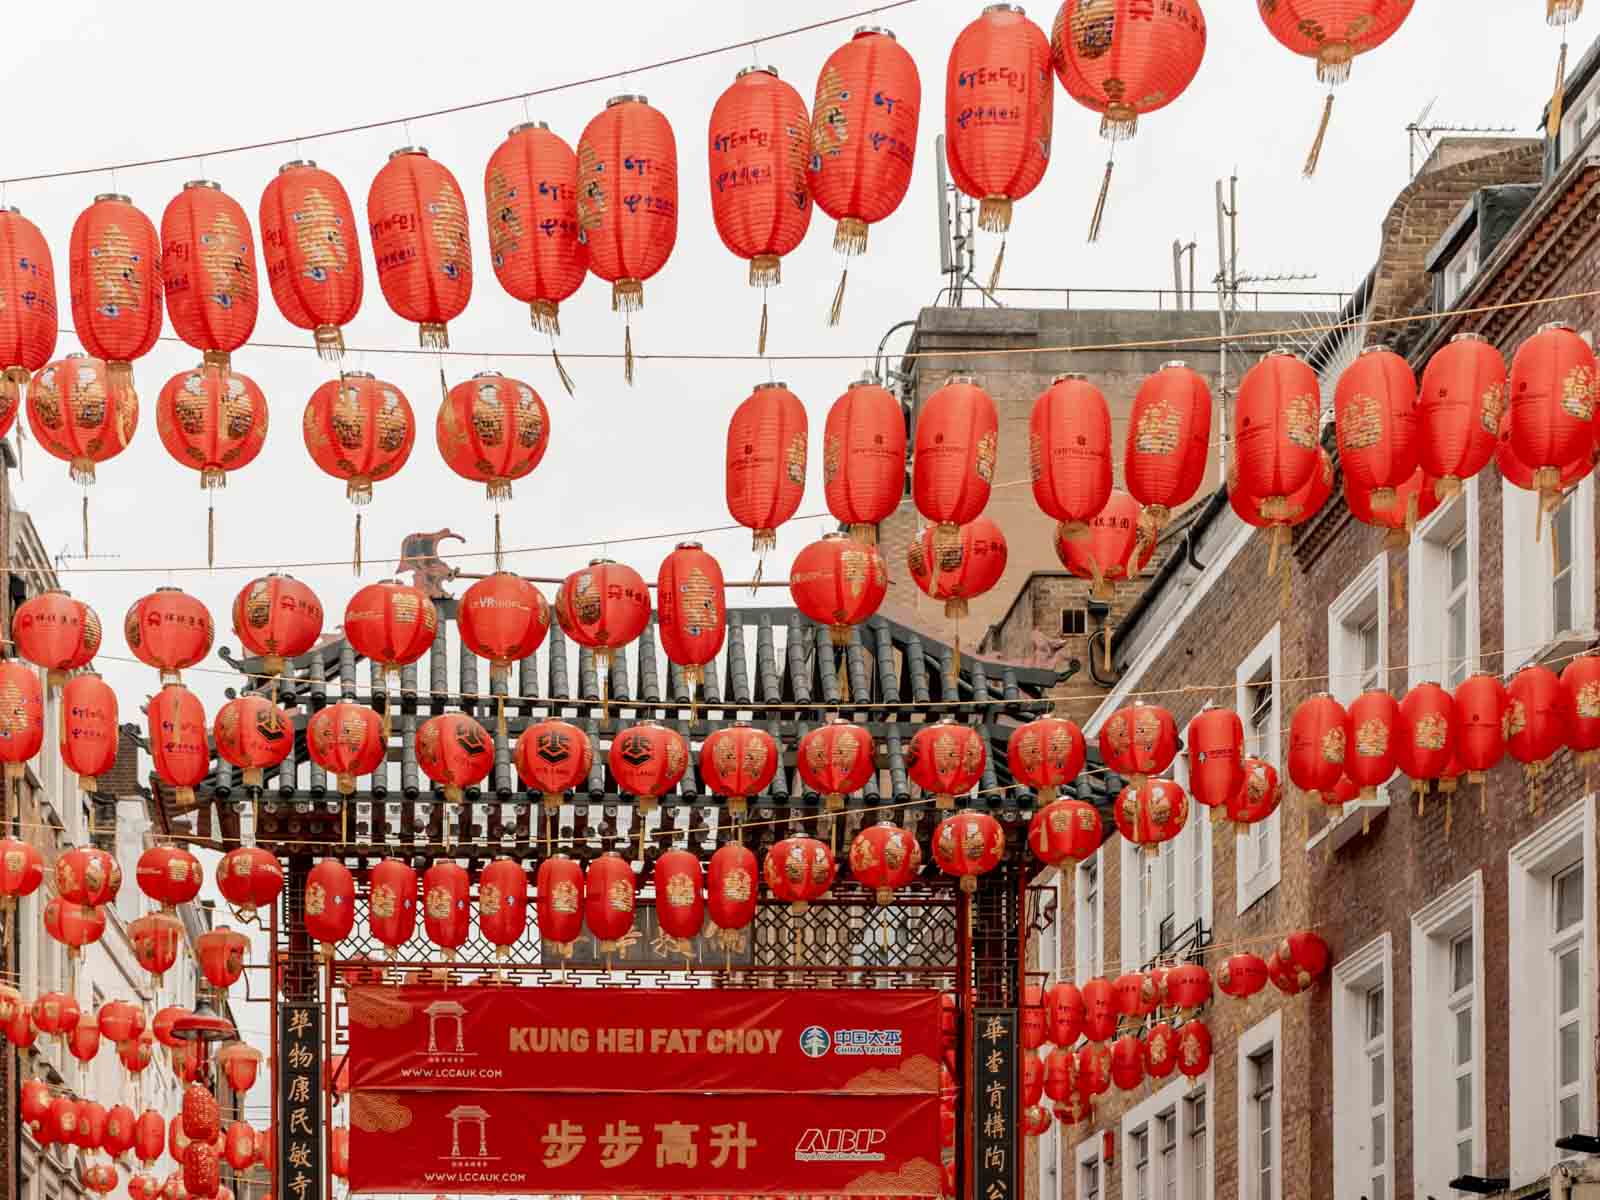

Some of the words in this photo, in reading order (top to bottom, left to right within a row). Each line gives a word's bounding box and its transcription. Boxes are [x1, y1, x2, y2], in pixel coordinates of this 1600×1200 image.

[509, 1027, 591, 1053] KUNG
[597, 1028, 644, 1053] HEI
[650, 1028, 702, 1054] FAT
[707, 1028, 783, 1054] CHOY
[834, 1029, 902, 1046] 中国太平
[541, 1119, 758, 1169] 步步高升
